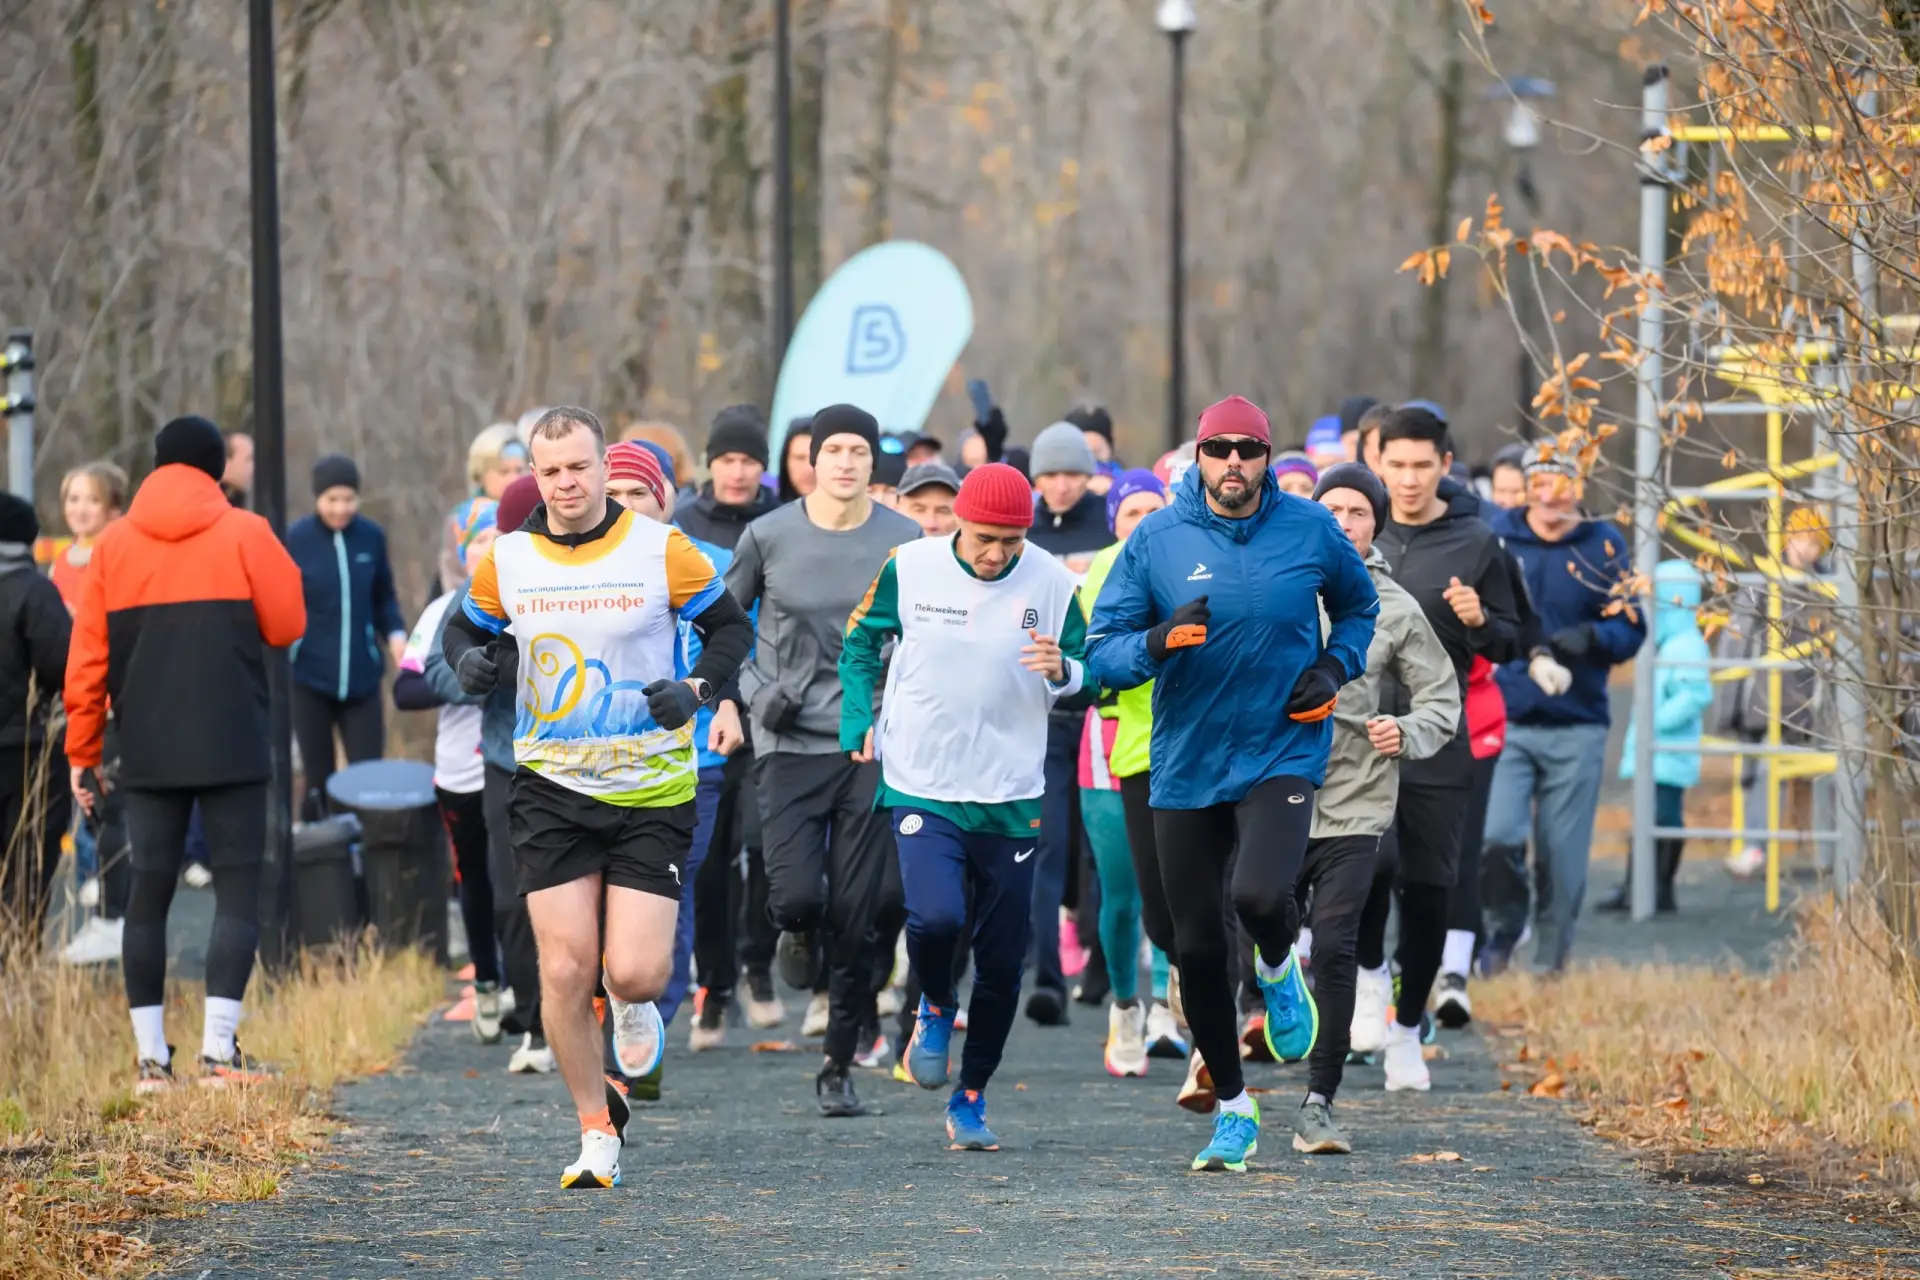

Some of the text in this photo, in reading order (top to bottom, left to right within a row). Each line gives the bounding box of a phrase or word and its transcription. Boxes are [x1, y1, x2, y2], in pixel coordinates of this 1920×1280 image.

[516, 581, 644, 594] Александрийские субботники
[516, 595, 645, 615] в Петергофе
[915, 603, 968, 617] Пейсмейкер
